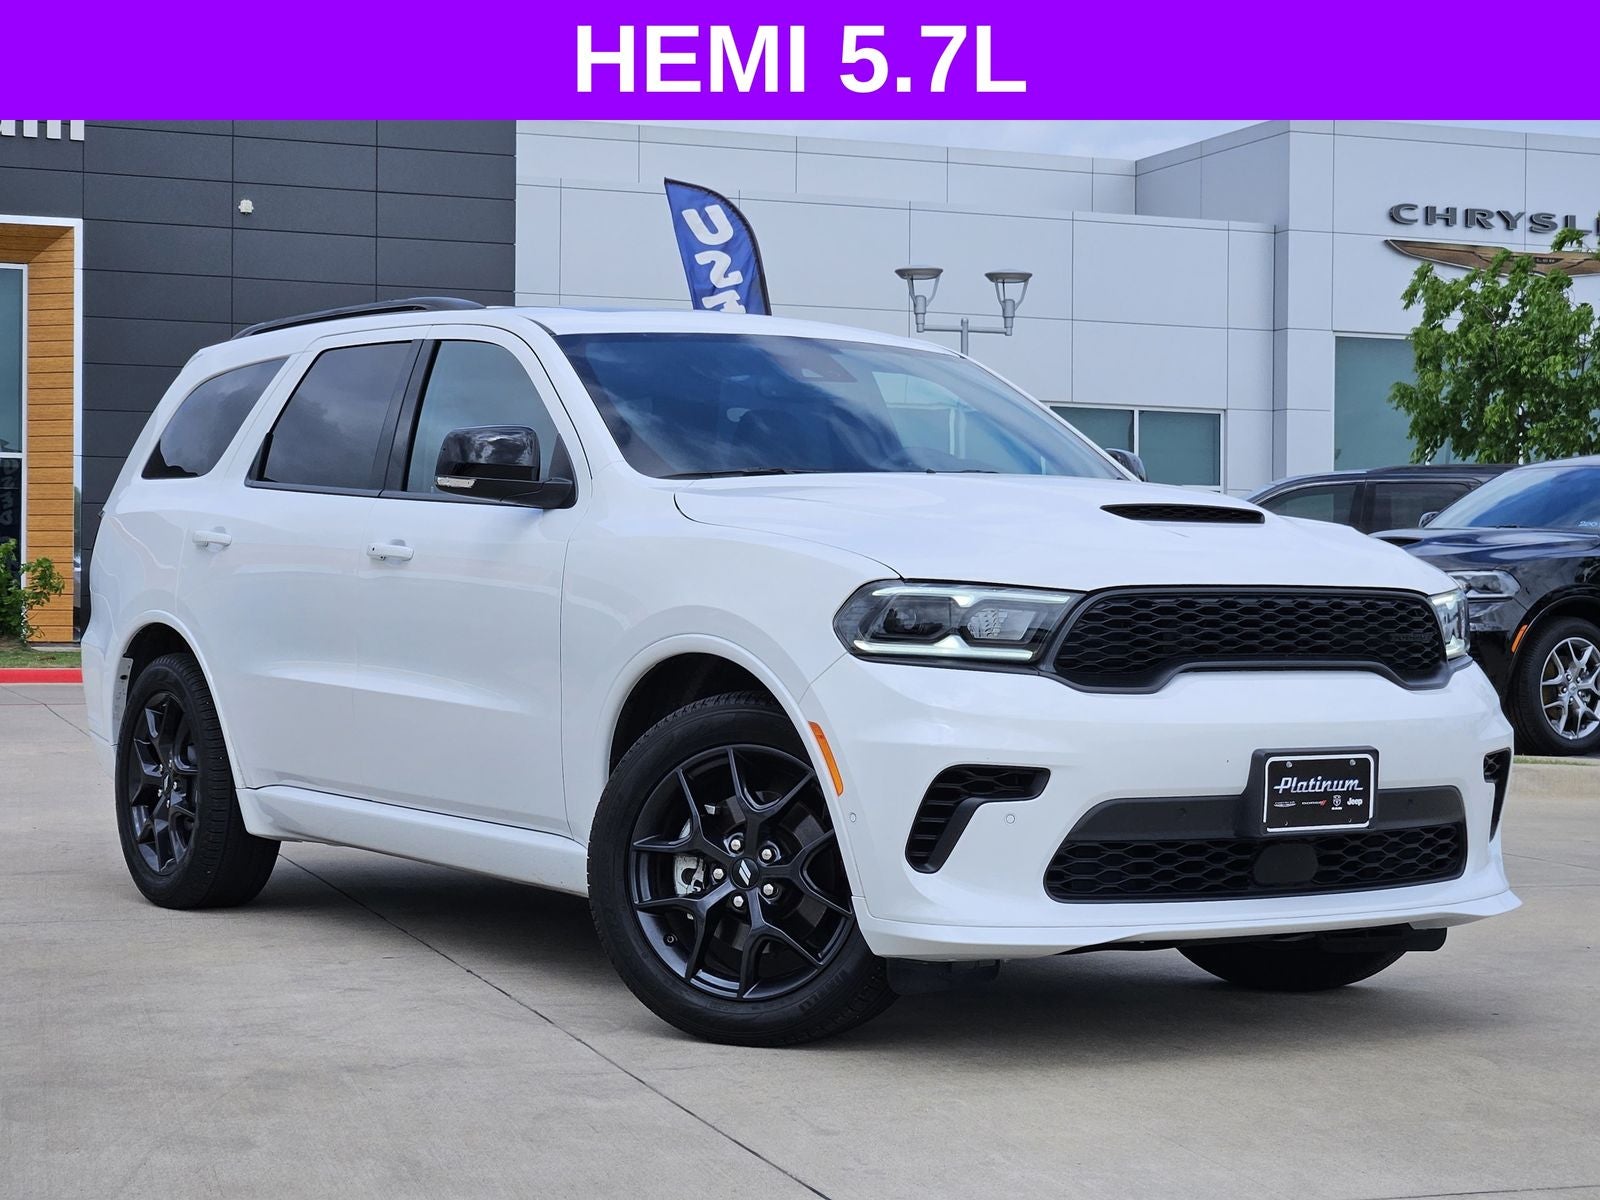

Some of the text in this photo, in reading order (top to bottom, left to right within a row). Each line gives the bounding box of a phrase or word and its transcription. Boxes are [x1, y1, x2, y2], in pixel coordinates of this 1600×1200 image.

[1389, 203, 1600, 236] CHRYSL
[1273, 776, 1364, 794] Platinum
[1346, 797, 1363, 807] Jeep
